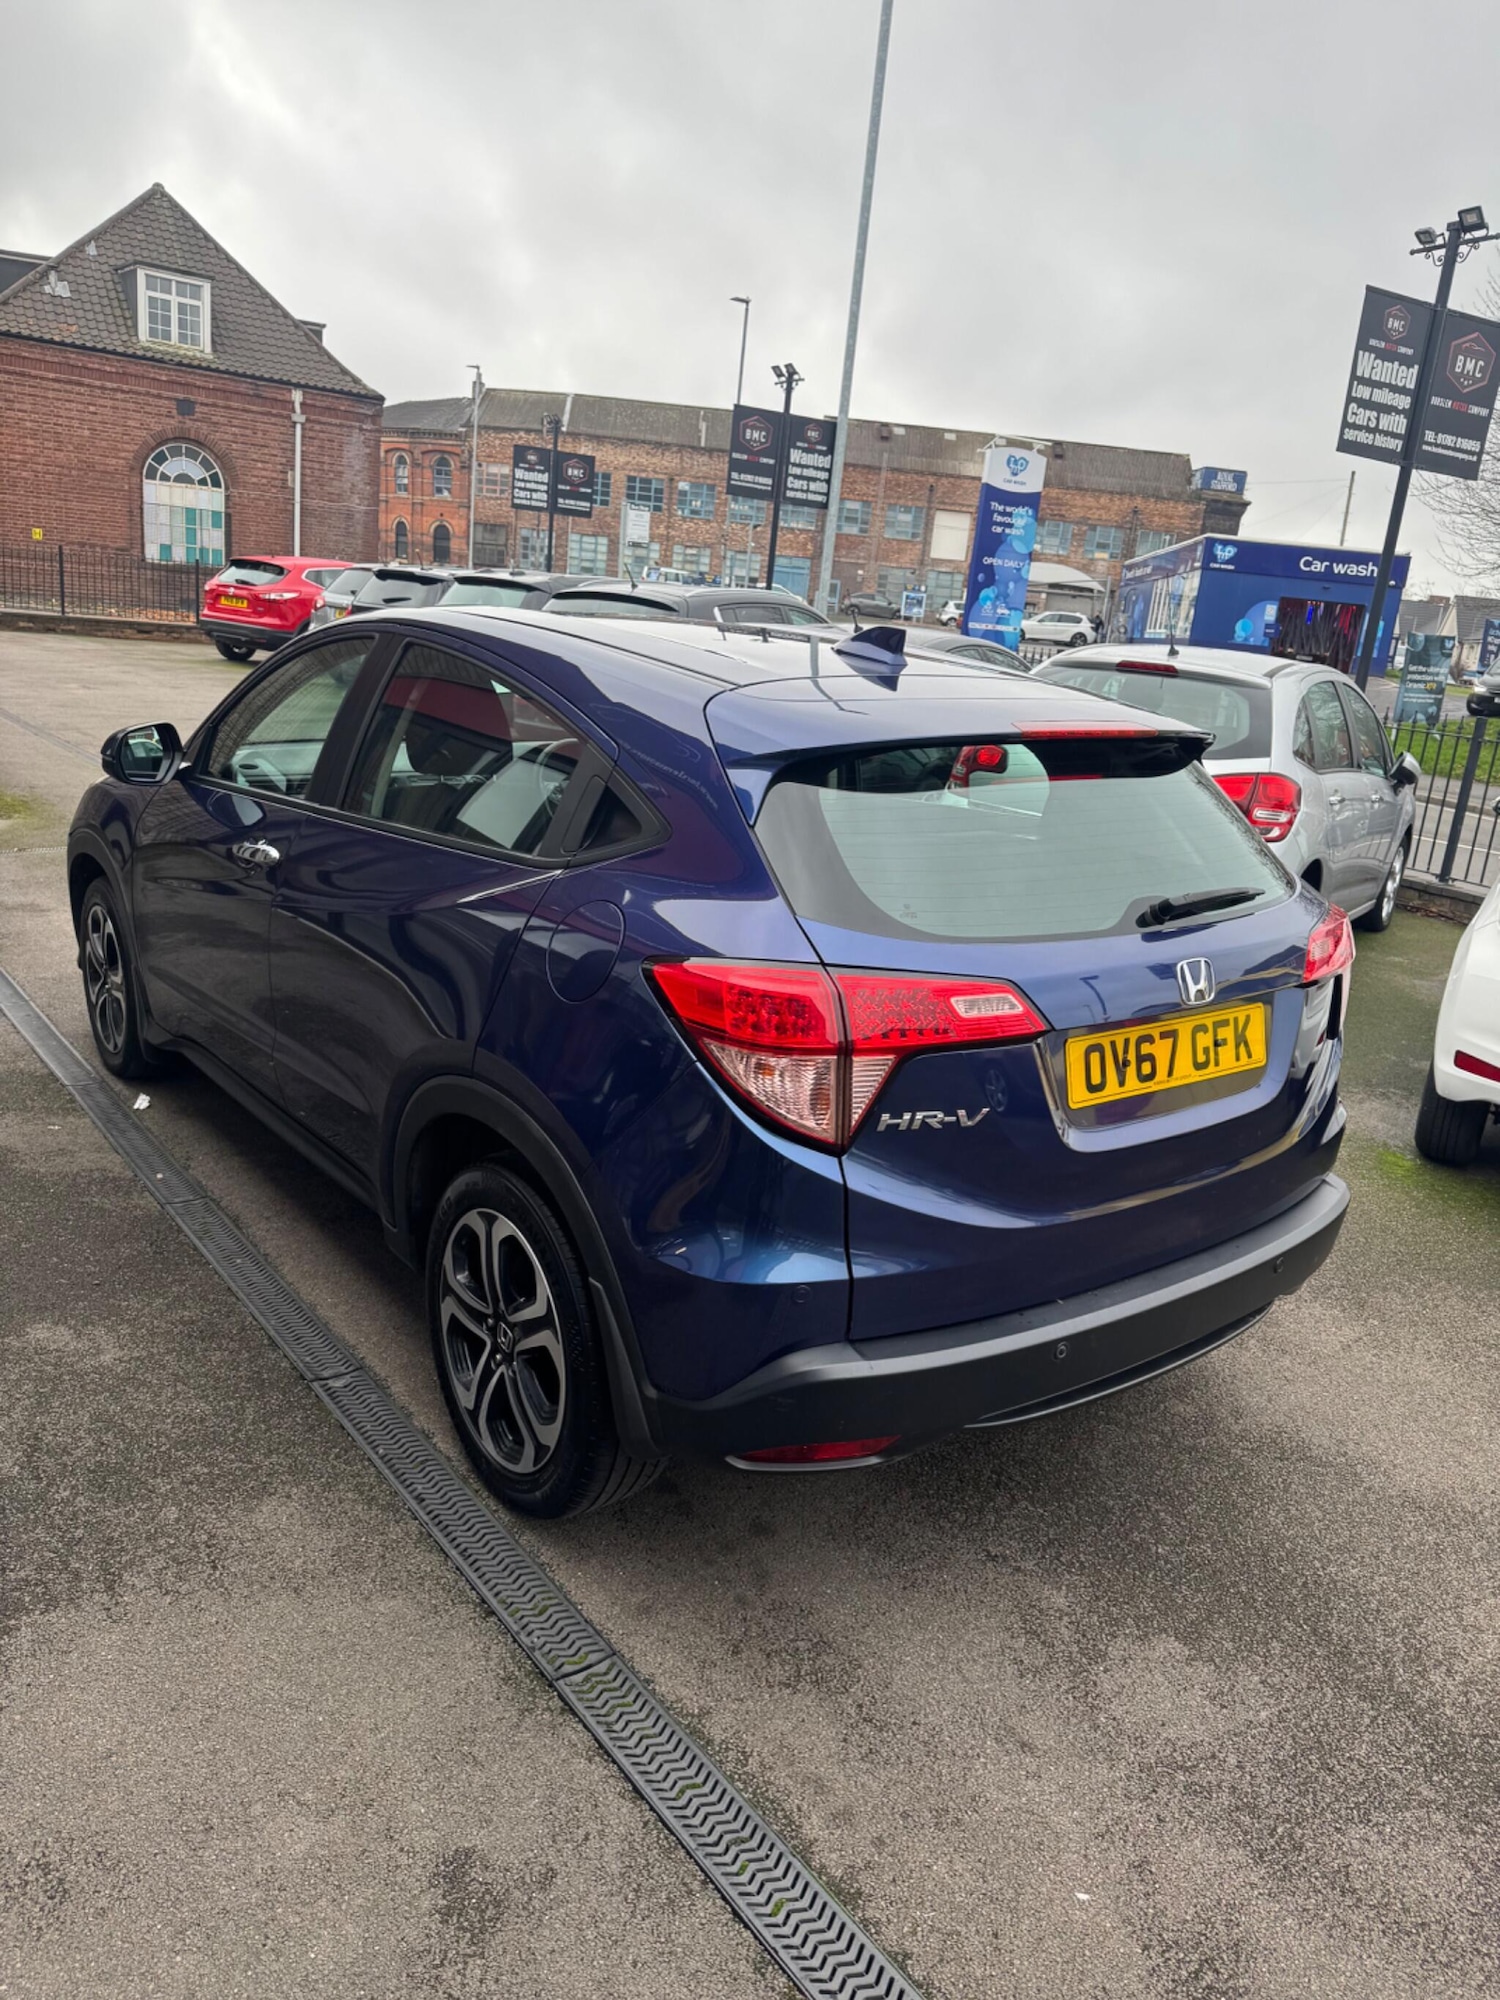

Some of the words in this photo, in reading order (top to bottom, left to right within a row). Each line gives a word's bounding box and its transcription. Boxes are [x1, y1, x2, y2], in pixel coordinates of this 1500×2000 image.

[1387, 317, 1405, 332] BMC
[1356, 350, 1419, 390] Wanted
[1455, 354, 1485, 378] BMC
[1351, 380, 1371, 399] Low
[1371, 386, 1411, 410] mileage
[1346, 403, 1378, 428] Cars
[1379, 412, 1408, 435] with
[745, 428, 766, 442] BMC
[1343, 427, 1373, 445] service
[1374, 435, 1403, 452] history
[790, 448, 832, 469] Wanted
[514, 467, 549, 484] Wanted
[567, 469, 584, 479] BMC
[788, 464, 801, 476] Low
[802, 467, 829, 480] mileage
[786, 476, 808, 491] Cars
[809, 480, 828, 493] with
[513, 488, 531, 500] Cars
[531, 490, 548, 501] with
[990, 501, 1004, 512] The
[1005, 505, 1033, 516] world's
[991, 525, 1004, 533] car
[1005, 527, 1025, 536] wash
[982, 556, 1002, 567] OPEN
[1003, 558, 1025, 569] DAILY
[1299, 556, 1330, 572] Car
[1332, 561, 1378, 577] wash
[1084, 1029, 1179, 1094] OV67
[1191, 1014, 1253, 1072] GFK
[876, 1108, 990, 1131] HR-V
